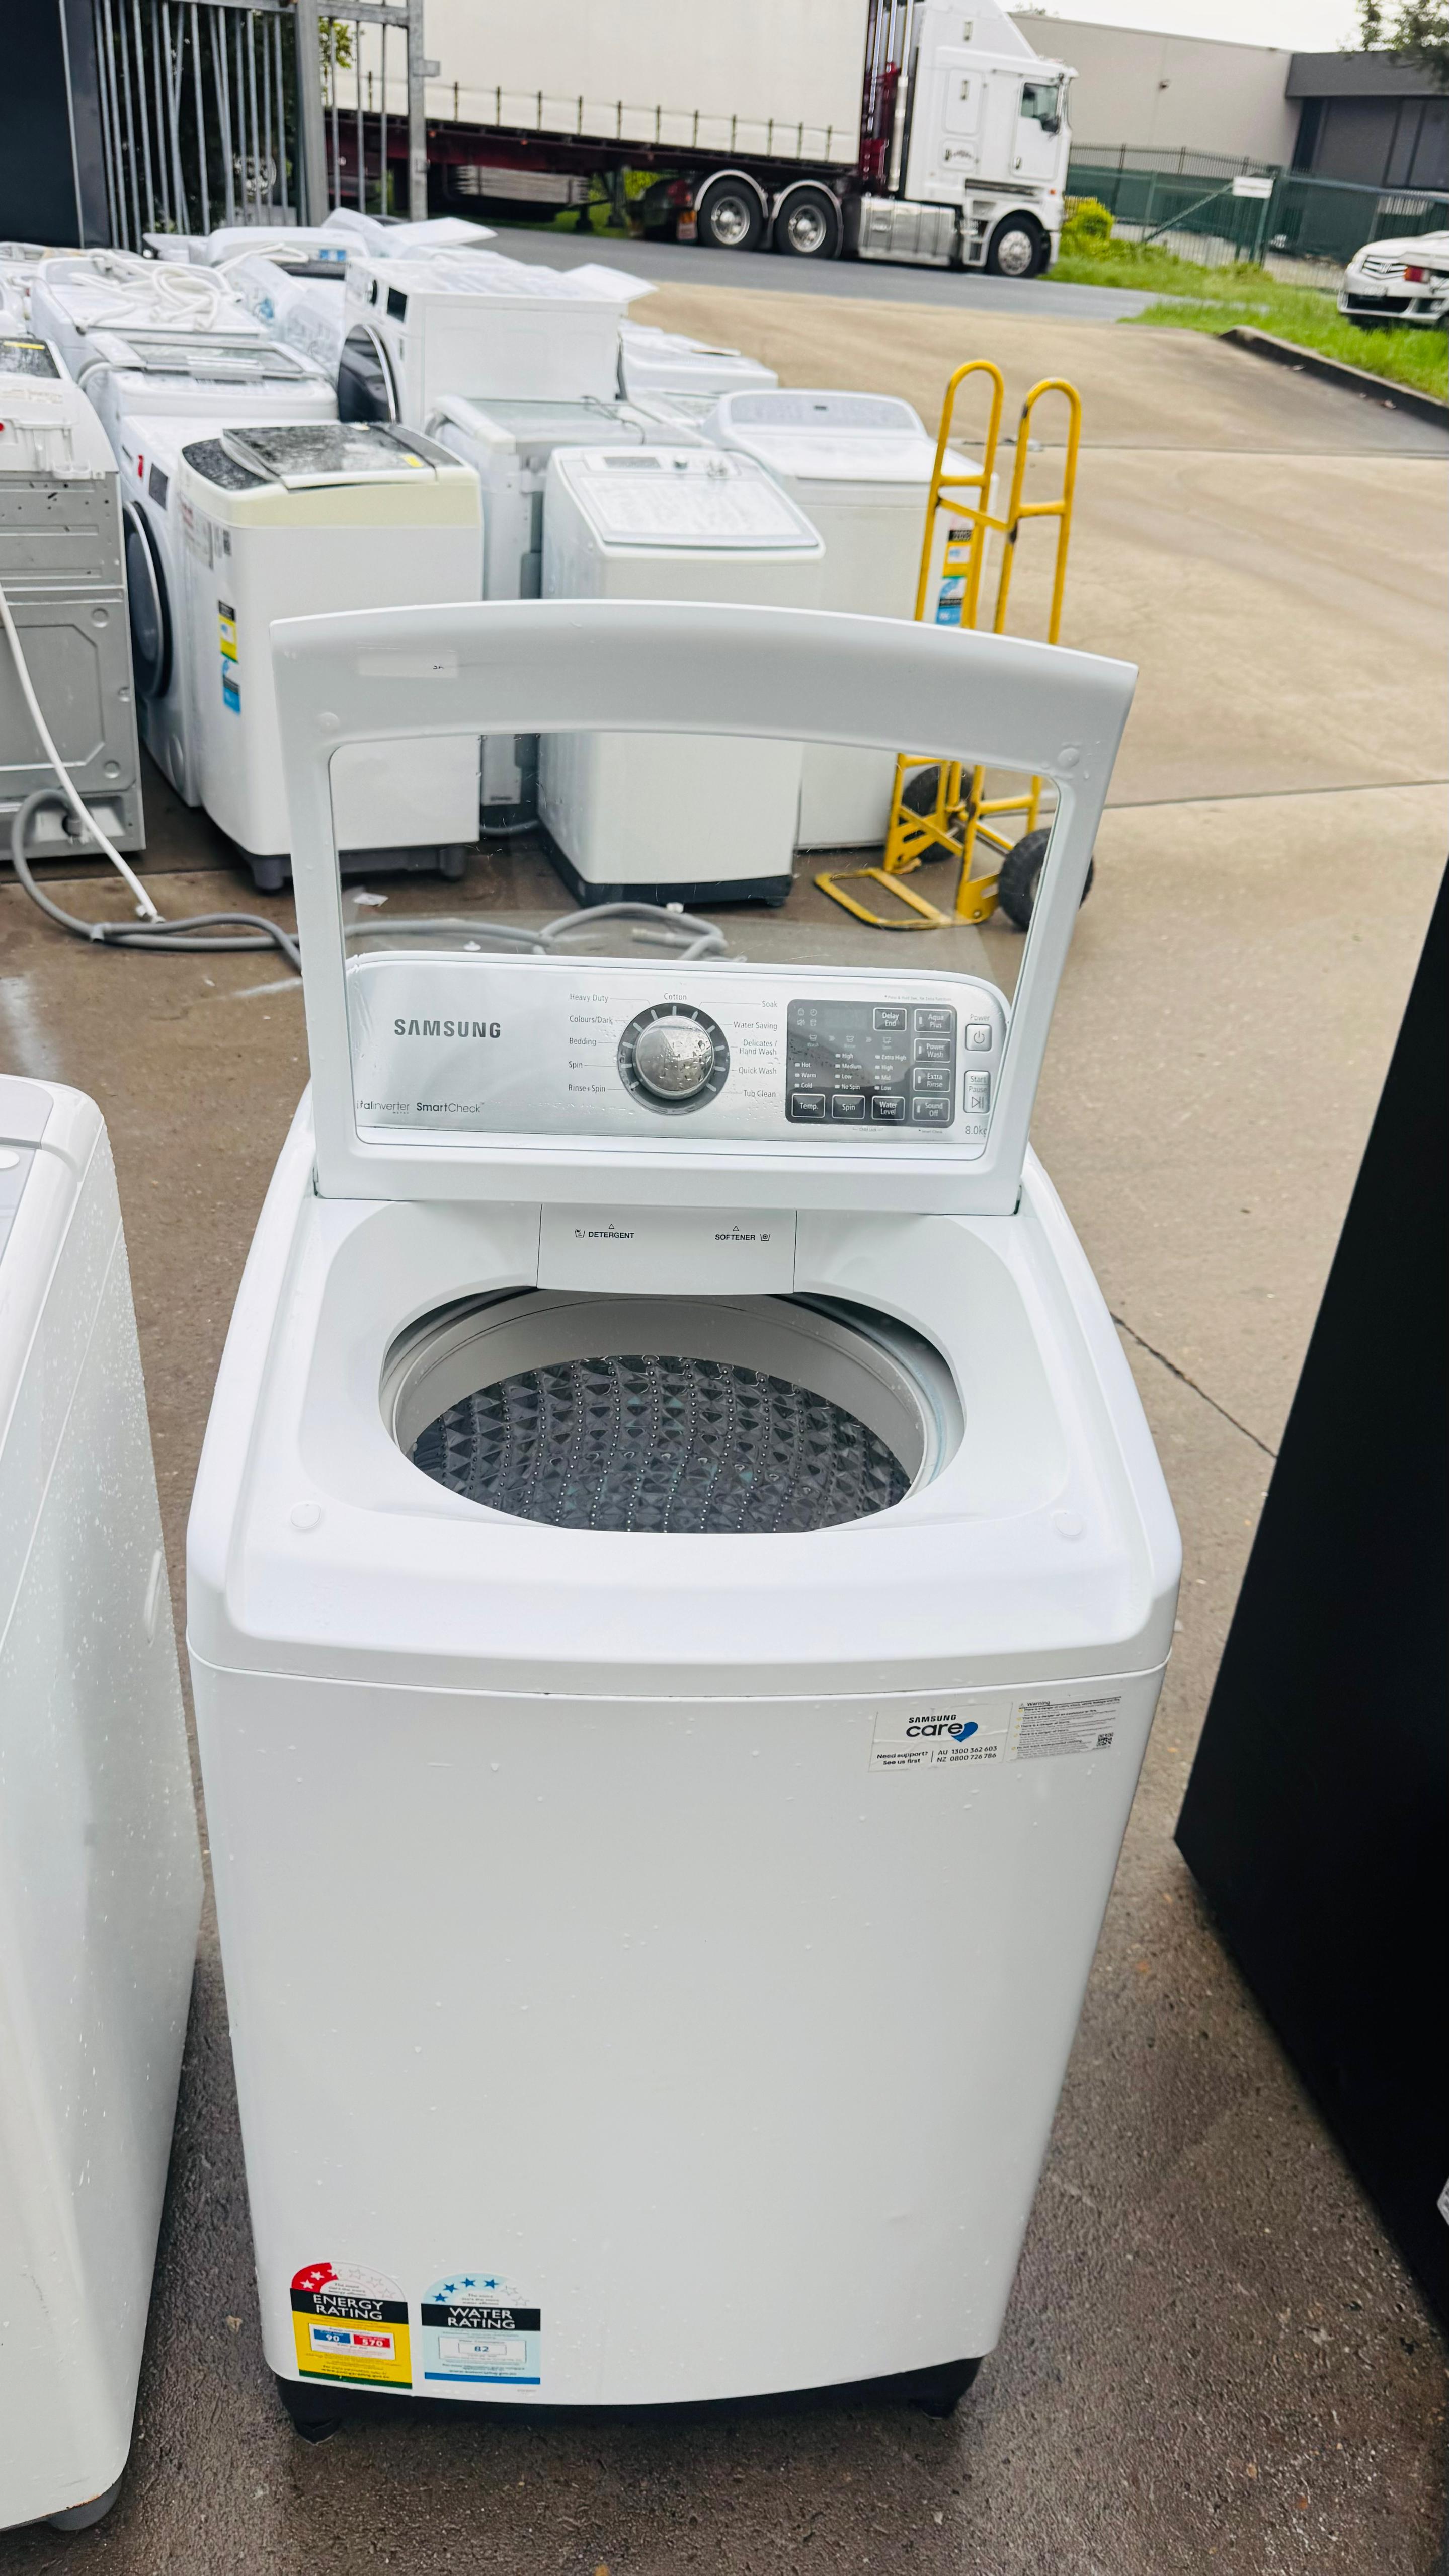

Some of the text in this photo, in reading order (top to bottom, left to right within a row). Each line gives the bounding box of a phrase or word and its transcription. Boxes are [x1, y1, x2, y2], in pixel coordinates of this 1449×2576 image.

[570, 994, 609, 1003] Heavy Duty
[570, 1015, 613, 1024] Colours/Dark
[882, 1012, 899, 1021] Delay
[394, 1019, 501, 1038] SAMSUNG
[756, 1022, 777, 1030] Saving
[569, 1037, 596, 1046] Bedding
[569, 1061, 583, 1069] Spin
[739, 1067, 756, 1075] Quick
[417, 1102, 480, 1113] SmartCheck
[800, 1102, 818, 1111] Temp.
[909, 1714, 957, 1723] SAMSUNG
[906, 1723, 963, 1737] care
[313, 2294, 383, 2310] ENERGY
[316, 2305, 382, 2320] RATING
[449, 2307, 513, 2319] WATER
[448, 2317, 515, 2329] RATING
[362, 2339, 383, 2347] 570
